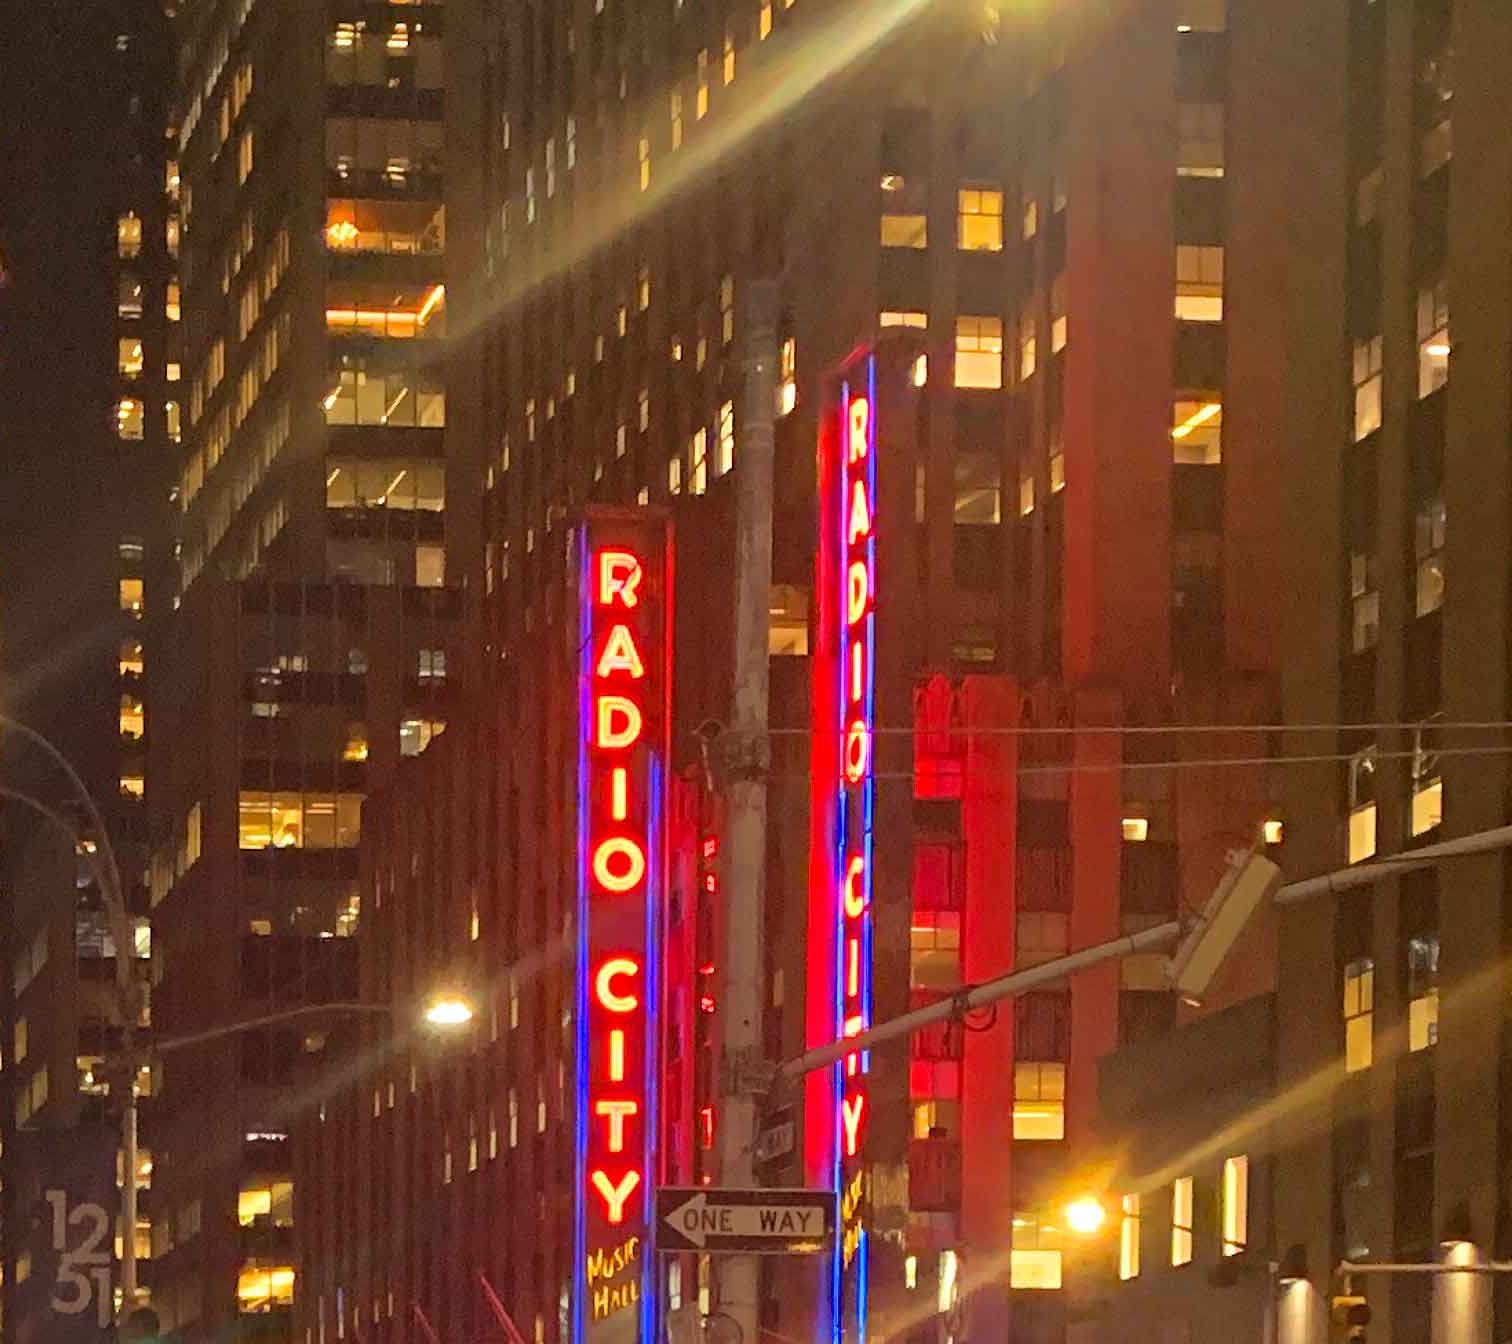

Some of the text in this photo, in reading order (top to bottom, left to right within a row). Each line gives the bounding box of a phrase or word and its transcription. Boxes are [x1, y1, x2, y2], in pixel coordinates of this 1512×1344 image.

[847, 397, 869, 784] RADIO
[590, 551, 646, 1223] RADIO CITY
[844, 855, 866, 1157] CITY
[682, 1209, 812, 1233] ONE WAY
